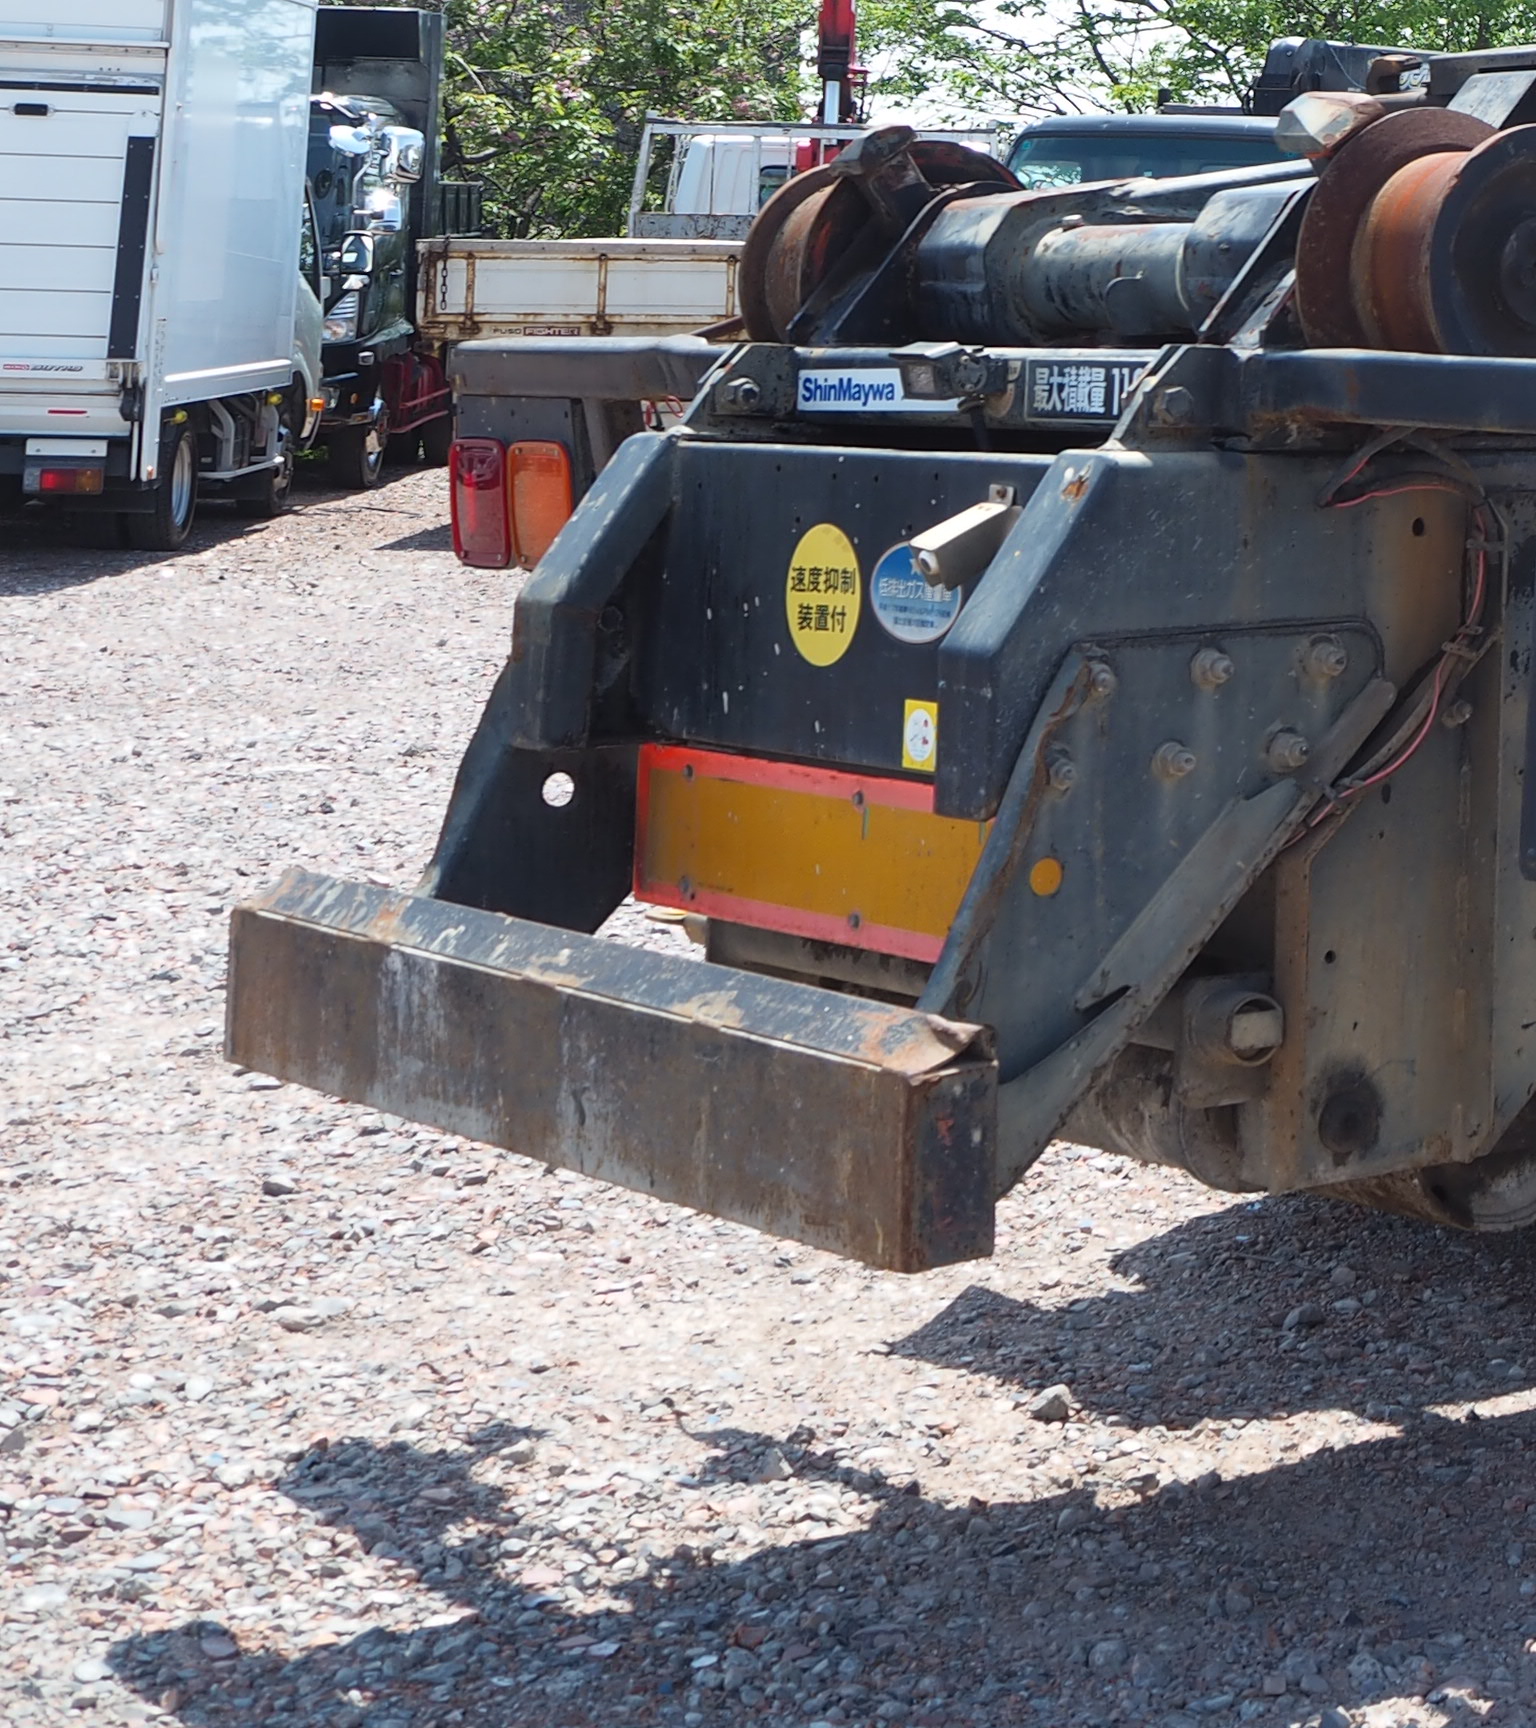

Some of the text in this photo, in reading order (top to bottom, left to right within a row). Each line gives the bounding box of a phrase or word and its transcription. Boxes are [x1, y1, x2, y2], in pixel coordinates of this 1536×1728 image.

[525, 327, 579, 336] FIGHTER
[802, 376, 895, 407] ShinMaywa
[1033, 364, 1107, 415] 最大積載量
[790, 566, 856, 595] 速度抑制
[797, 602, 847, 633] 装置付
